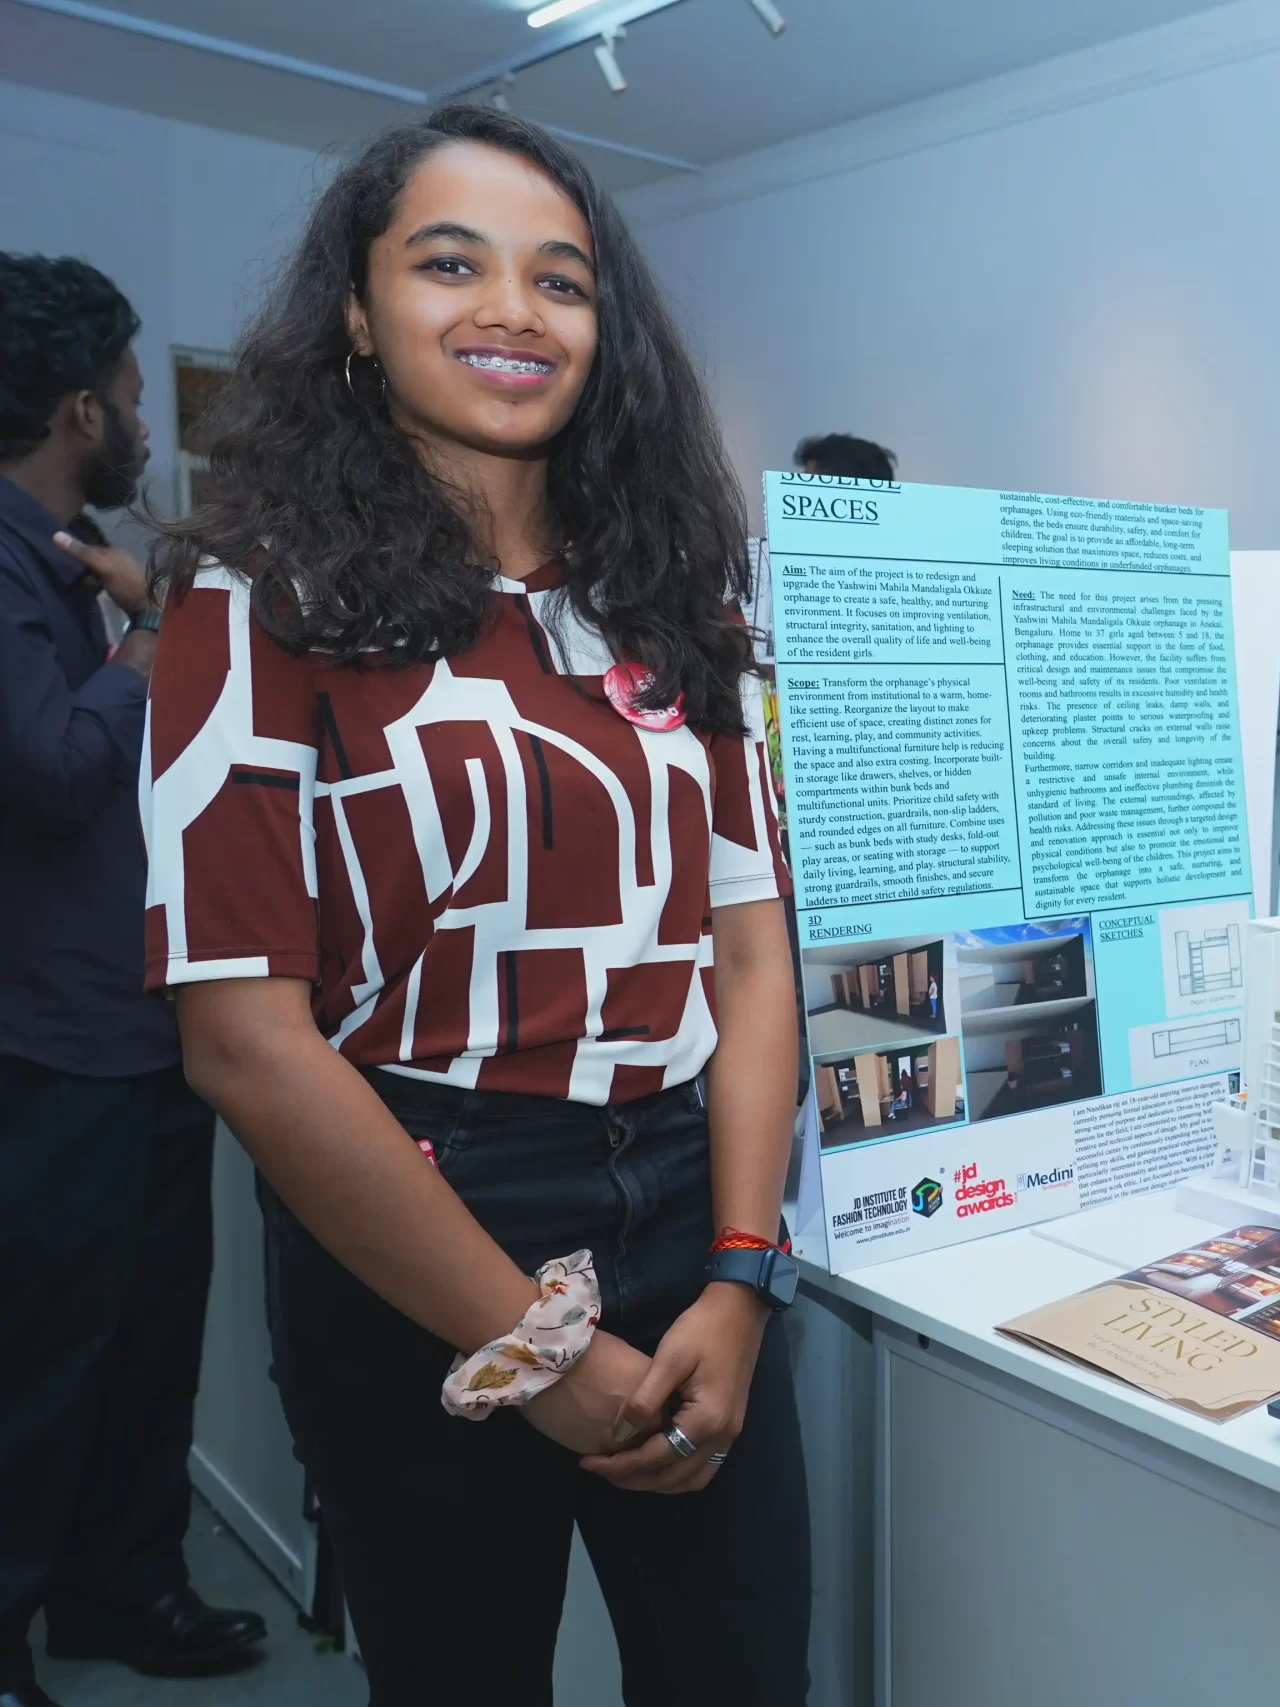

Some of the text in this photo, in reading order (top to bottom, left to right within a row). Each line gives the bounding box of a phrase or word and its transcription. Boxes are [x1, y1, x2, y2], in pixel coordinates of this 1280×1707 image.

[782, 494, 879, 521] SPACES
[1036, 532, 1050, 541] The
[1052, 533, 1067, 544] goal
[1070, 534, 1076, 542] is
[1087, 535, 1113, 545] provide
[1163, 539, 1194, 551] long-term
[782, 565, 975, 584] Aim: The aim of the project is to redesign and
[783, 581, 991, 596] upgrade the Yashwini Mahila Mandaligala Okkute
[1012, 590, 1035, 599] Need:
[1040, 591, 1054, 600] The
[1058, 592, 1075, 601] need
[1080, 592, 1090, 601] for
[1095, 592, 1107, 602] this
[1112, 593, 1135, 605] project
[1139, 594, 1159, 603] arises
[1163, 594, 1178, 604] from
[784, 607, 843, 617] environment.
[846, 608, 852, 617] It
[855, 608, 886, 618] focuses
[902, 609, 944, 622] improving
[946, 610, 990, 621] ventilation,
[1059, 628, 1080, 637] Home
[1084, 629, 1092, 637] to
[1096, 628, 1104, 637] 37
[1108, 628, 1124, 640] girls
[1128, 629, 1144, 640] aged
[1147, 629, 1174, 638] between
[787, 648, 874, 660] of the resident girls.
[787, 677, 970, 689] Scope: Transform the orphanage’s physical
[793, 746, 825, 758] Having
[836, 743, 901, 754] multifunctional
[904, 743, 939, 752] furniture
[941, 742, 959, 753] help
[961, 741, 968, 750] is
[970, 740, 1004, 752] reducing
[797, 791, 998, 810] multifunctional units. Prioritize child safety with
[805, 882, 993, 906] ladders to meet strict child safety regulations.
[1035, 898, 1061, 911] dignity
[1063, 897, 1073, 906] for
[1075, 897, 1095, 906] every
[808, 915, 822, 925] 3D
[1099, 915, 1155, 929] CONCEPTUAL
[809, 923, 872, 939] RENDERING
[1100, 928, 1144, 940] SKETCHES
[1189, 1058, 1210, 1068] PLAN
[953, 1163, 977, 1184] #jd
[1027, 1164, 1073, 1188] Medini
[853, 1187, 907, 1210] JD INSTITUTE OF
[955, 1178, 1006, 1201] design
[832, 1209, 863, 1228] FASHION
[864, 1199, 908, 1220] TECHNOLOGY
[956, 1192, 1014, 1217] awards
[834, 1216, 910, 1240] Welcome to Imagination
[1129, 1298, 1258, 1357] STYLED
[1103, 1313, 1223, 1371] LIVING
